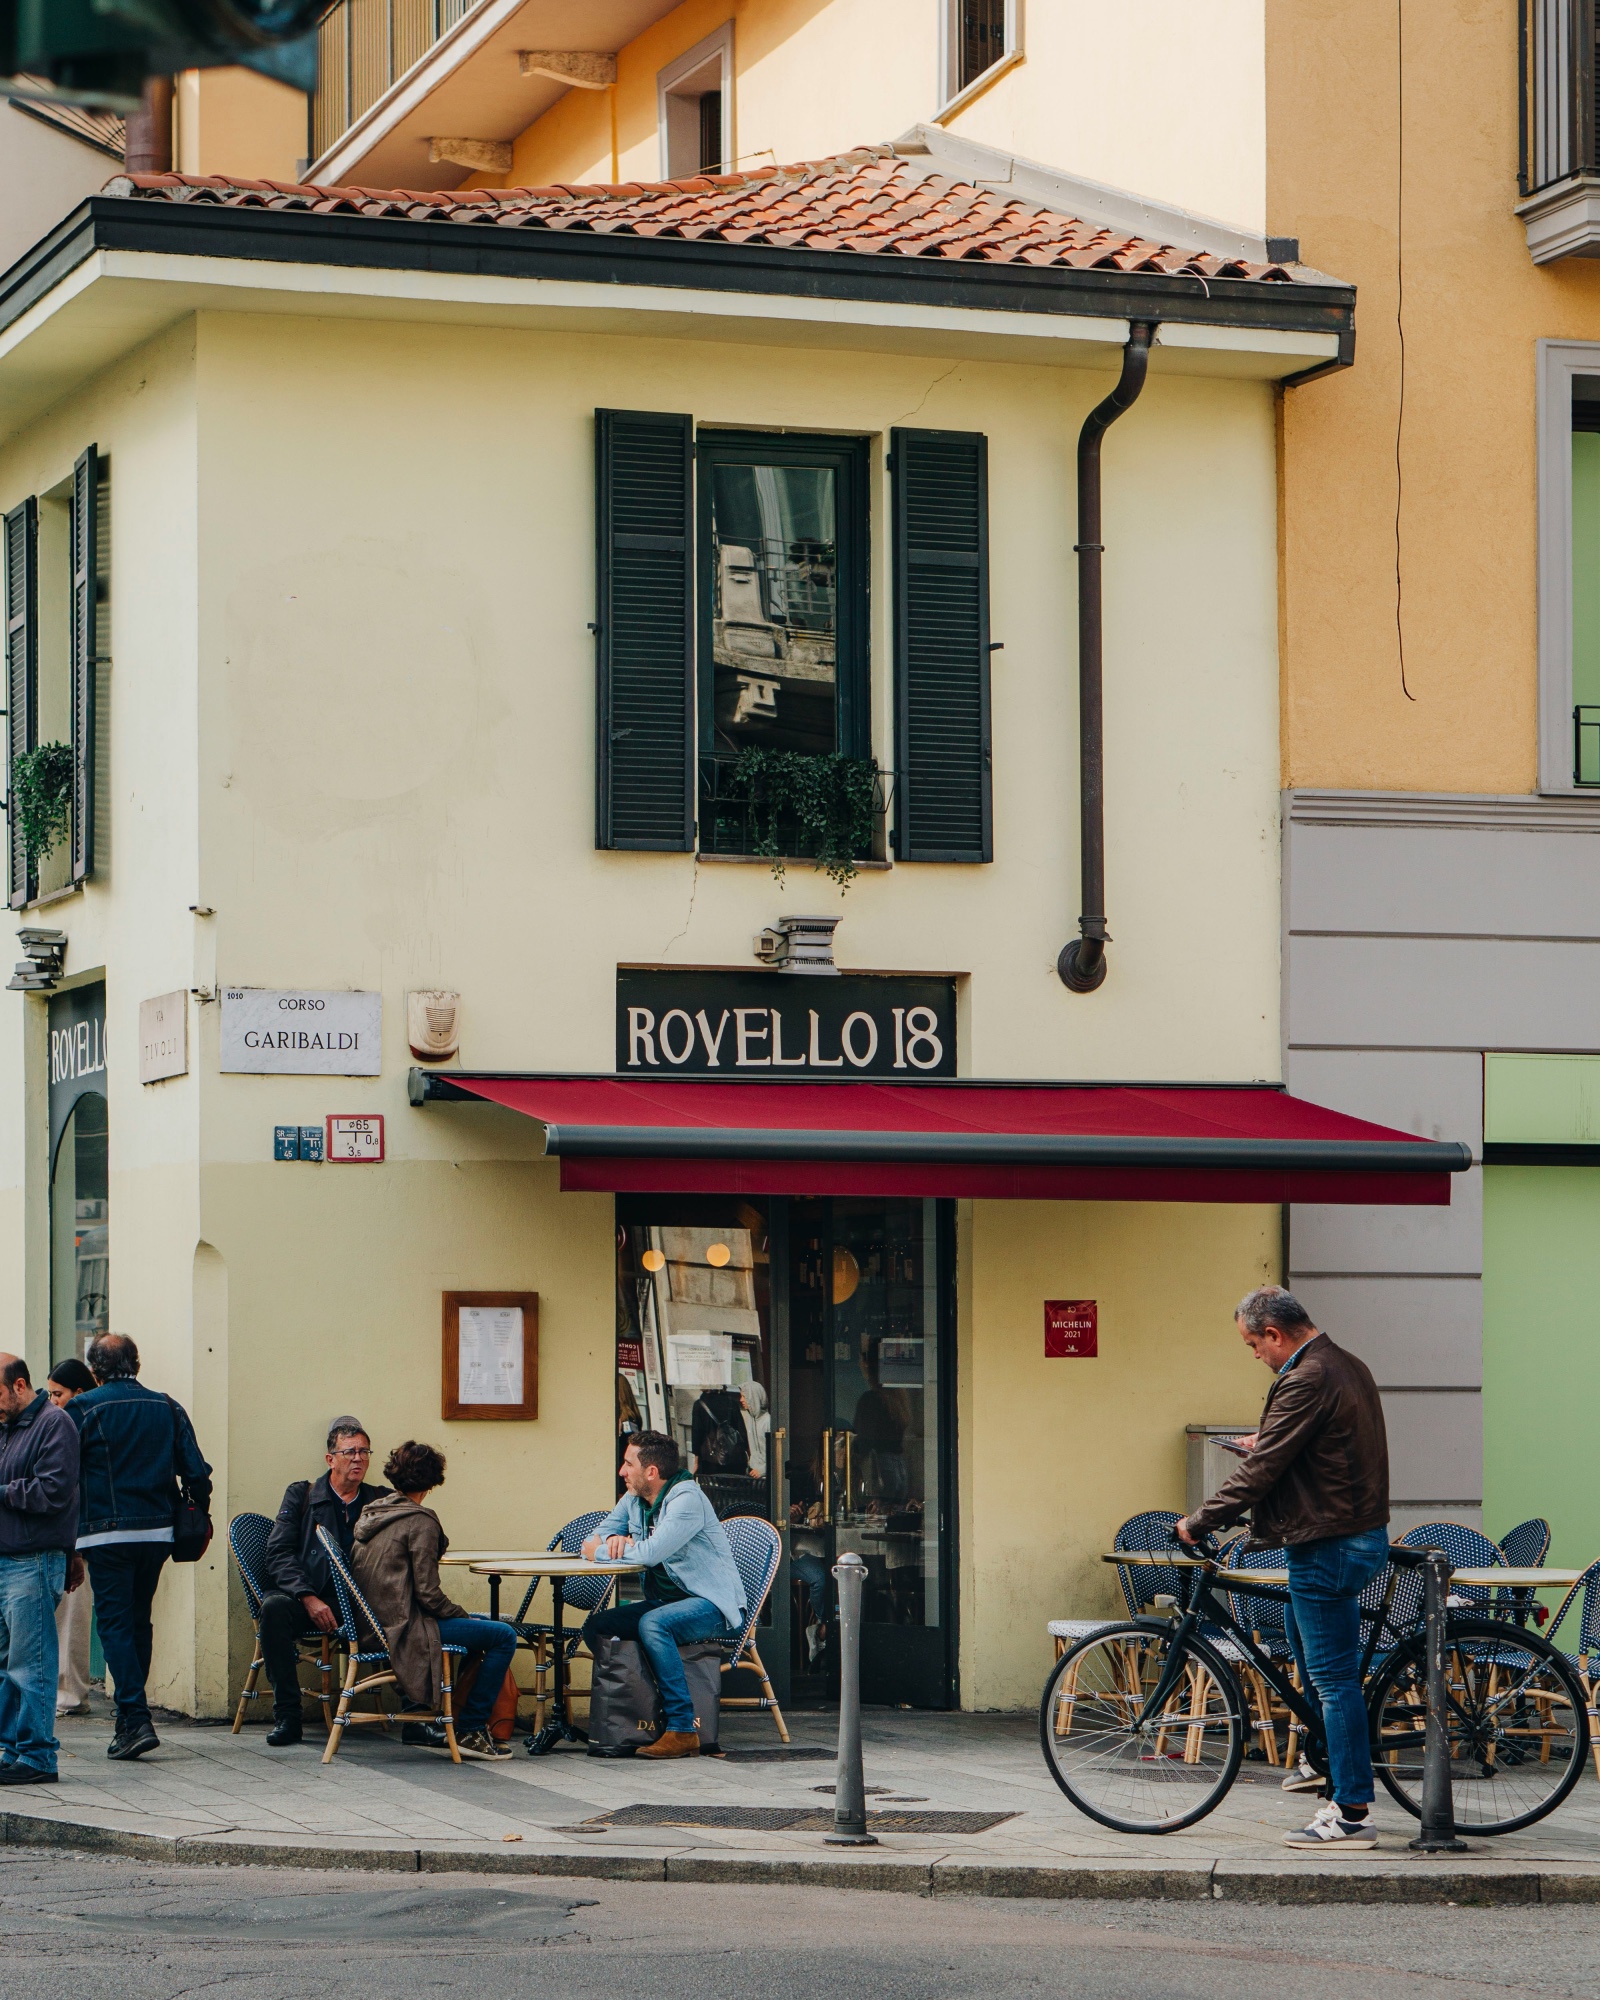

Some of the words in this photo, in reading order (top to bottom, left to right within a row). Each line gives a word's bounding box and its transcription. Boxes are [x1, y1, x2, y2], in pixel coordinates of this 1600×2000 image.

[227, 992, 244, 1000] 1010
[278, 998, 325, 1011] CORSO
[244, 1031, 359, 1050] GARIBALDI
[627, 1007, 879, 1068] ROVELLO
[892, 1006, 943, 1070] 18
[1052, 1321, 1092, 1329] MICHELIN
[1064, 1330, 1081, 1338] 2021
